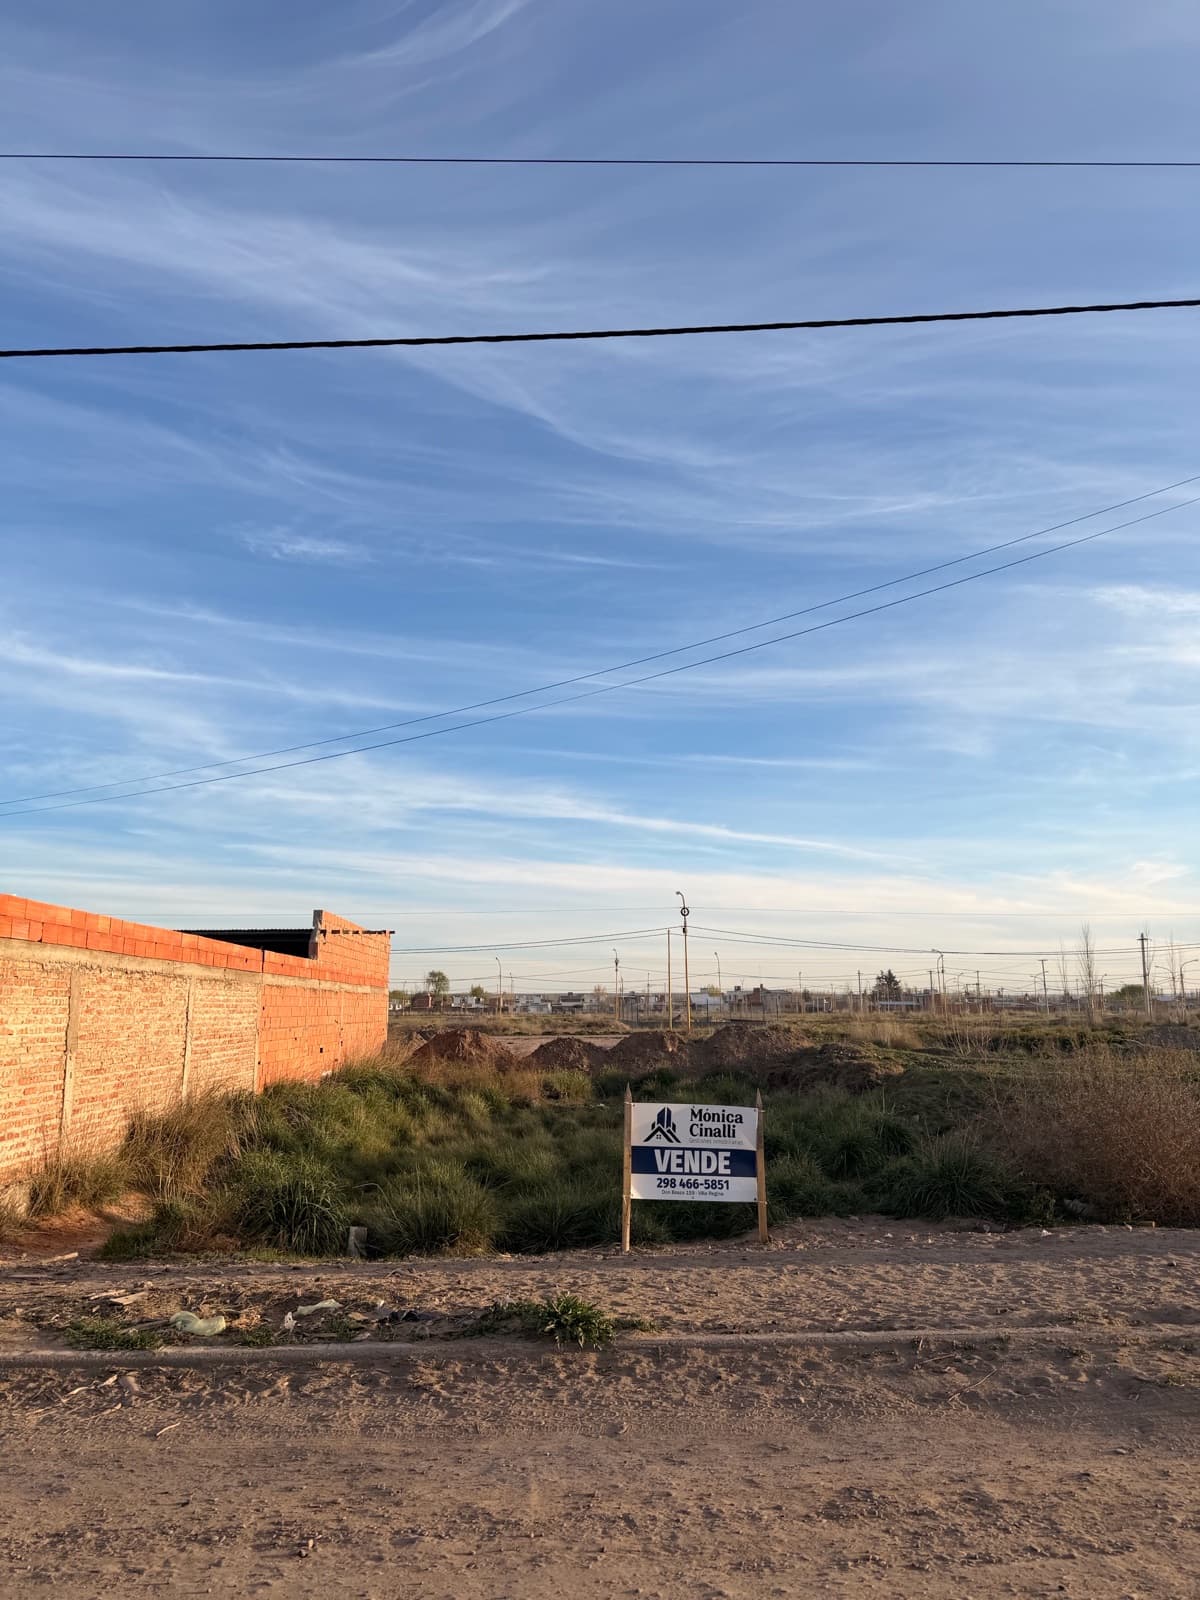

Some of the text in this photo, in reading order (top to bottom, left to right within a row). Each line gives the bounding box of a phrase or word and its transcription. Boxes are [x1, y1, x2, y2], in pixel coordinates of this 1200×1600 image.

[690, 1108, 743, 1123] Mónica
[689, 1123, 736, 1138] Cinalli
[654, 1149, 732, 1175] VENDE
[656, 1178, 730, 1191] 298 466-5851
